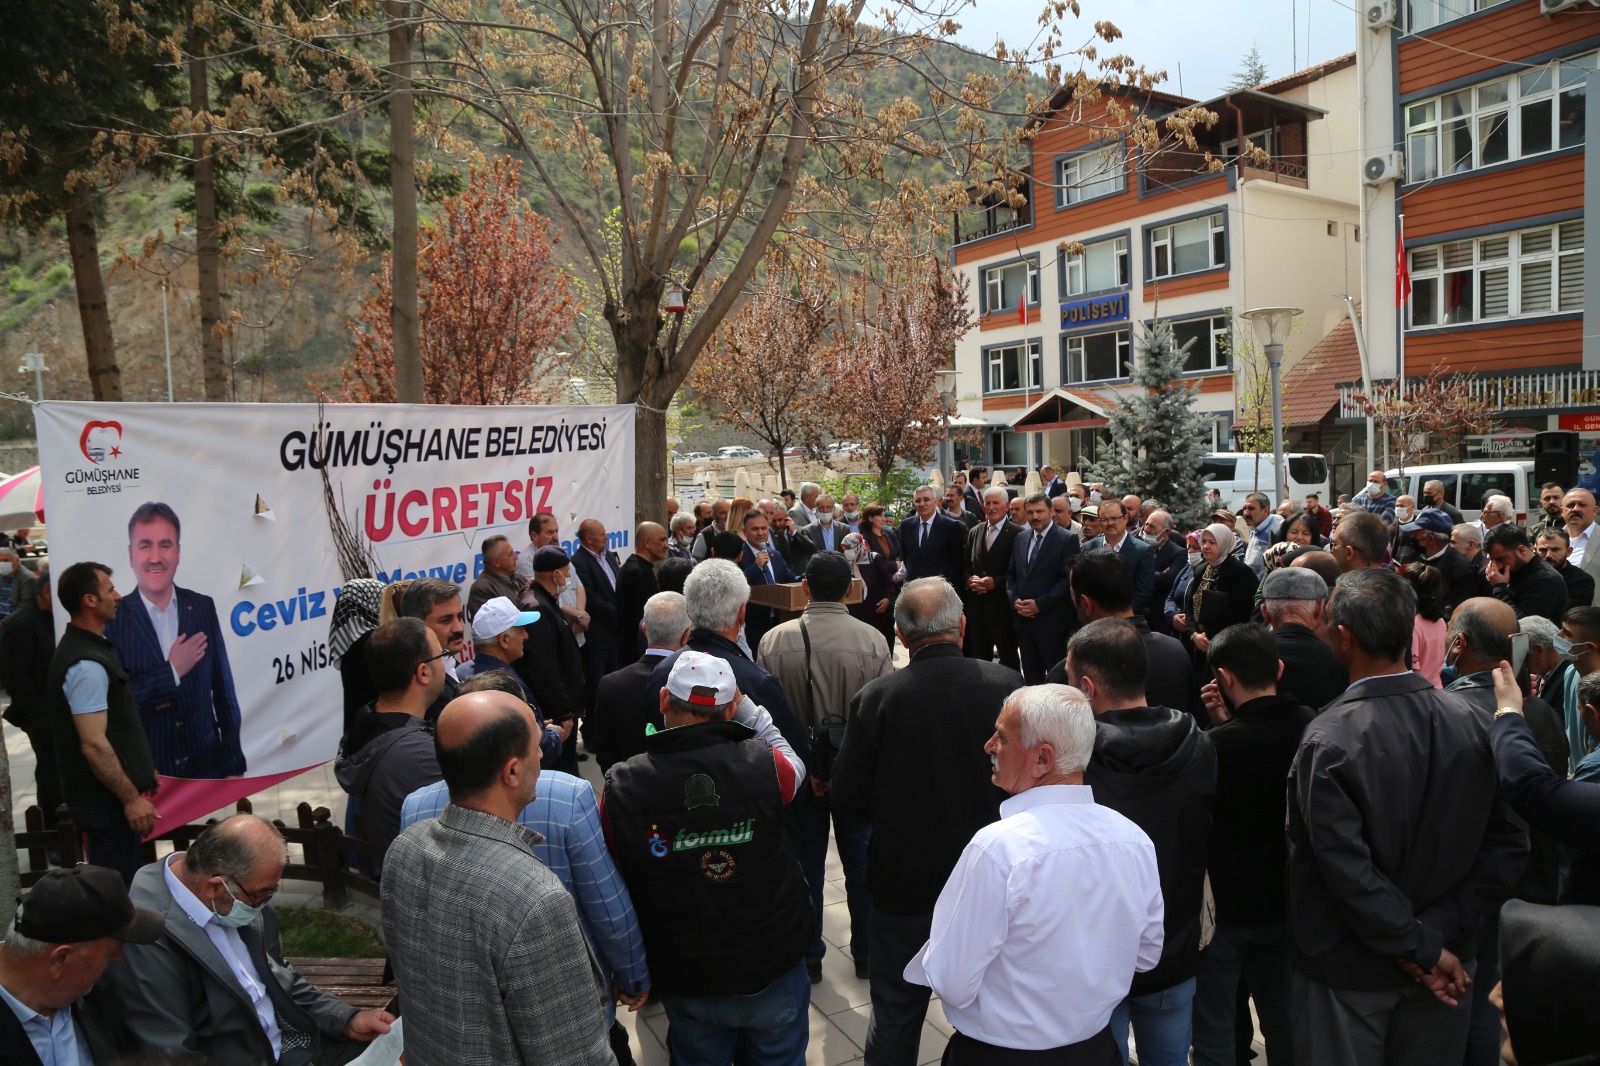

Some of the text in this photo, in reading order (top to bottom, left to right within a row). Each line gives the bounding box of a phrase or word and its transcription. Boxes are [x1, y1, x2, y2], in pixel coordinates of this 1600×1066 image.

[1061, 296, 1124, 324] POLİSEVİ
[280, 417, 607, 474] GÜMÜŞHANE BELEDİYESİ
[65, 468, 139, 484] GÜMÜŞHANE
[87, 483, 121, 495] BELEDİYESİ
[364, 466, 553, 543] ÜCRETSİZ
[230, 587, 327, 637] Ceviz
[273, 654, 295, 685] 26
[674, 819, 754, 850] formül
